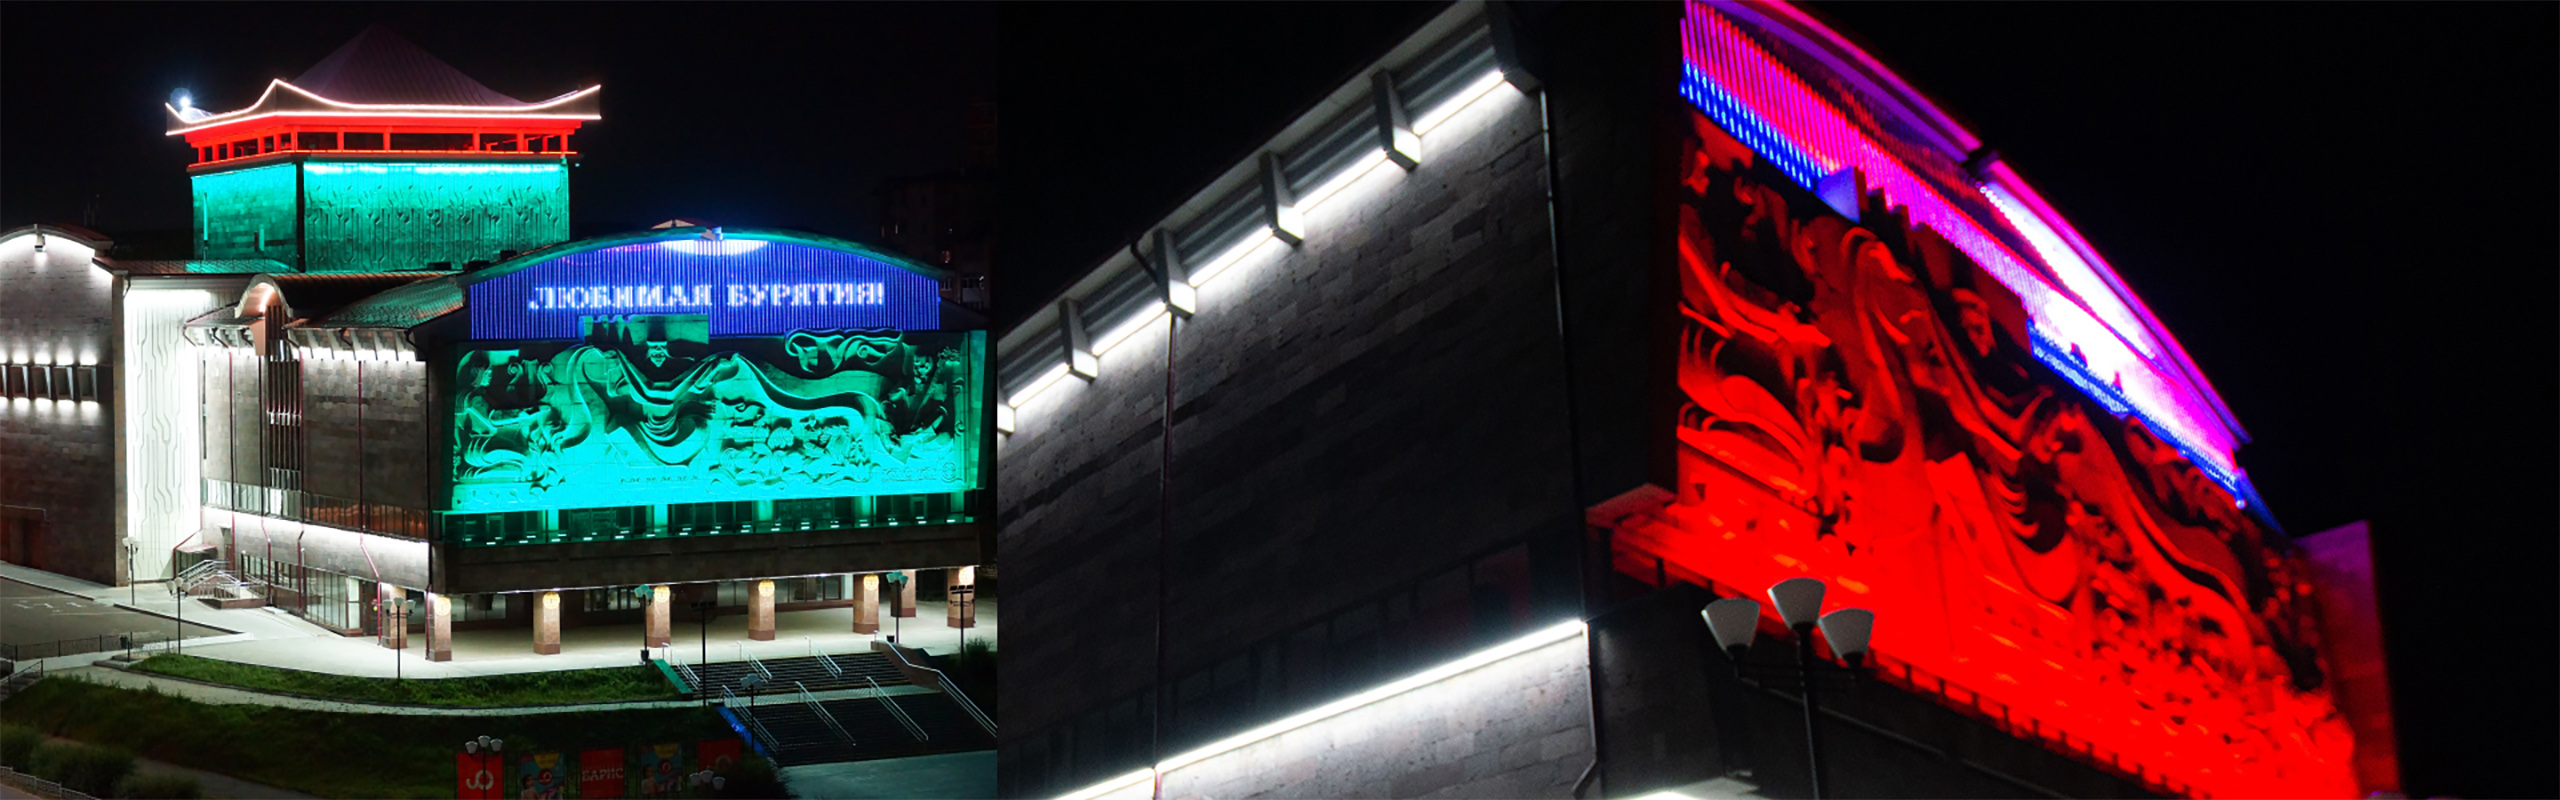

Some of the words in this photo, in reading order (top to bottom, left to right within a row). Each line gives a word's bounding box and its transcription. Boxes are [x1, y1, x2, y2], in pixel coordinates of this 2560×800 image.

[528, 285, 713, 310] ЛЮБИМАЯ
[727, 282, 886, 307] БУРЯТИЯ!
[581, 767, 624, 783] БАРИС
